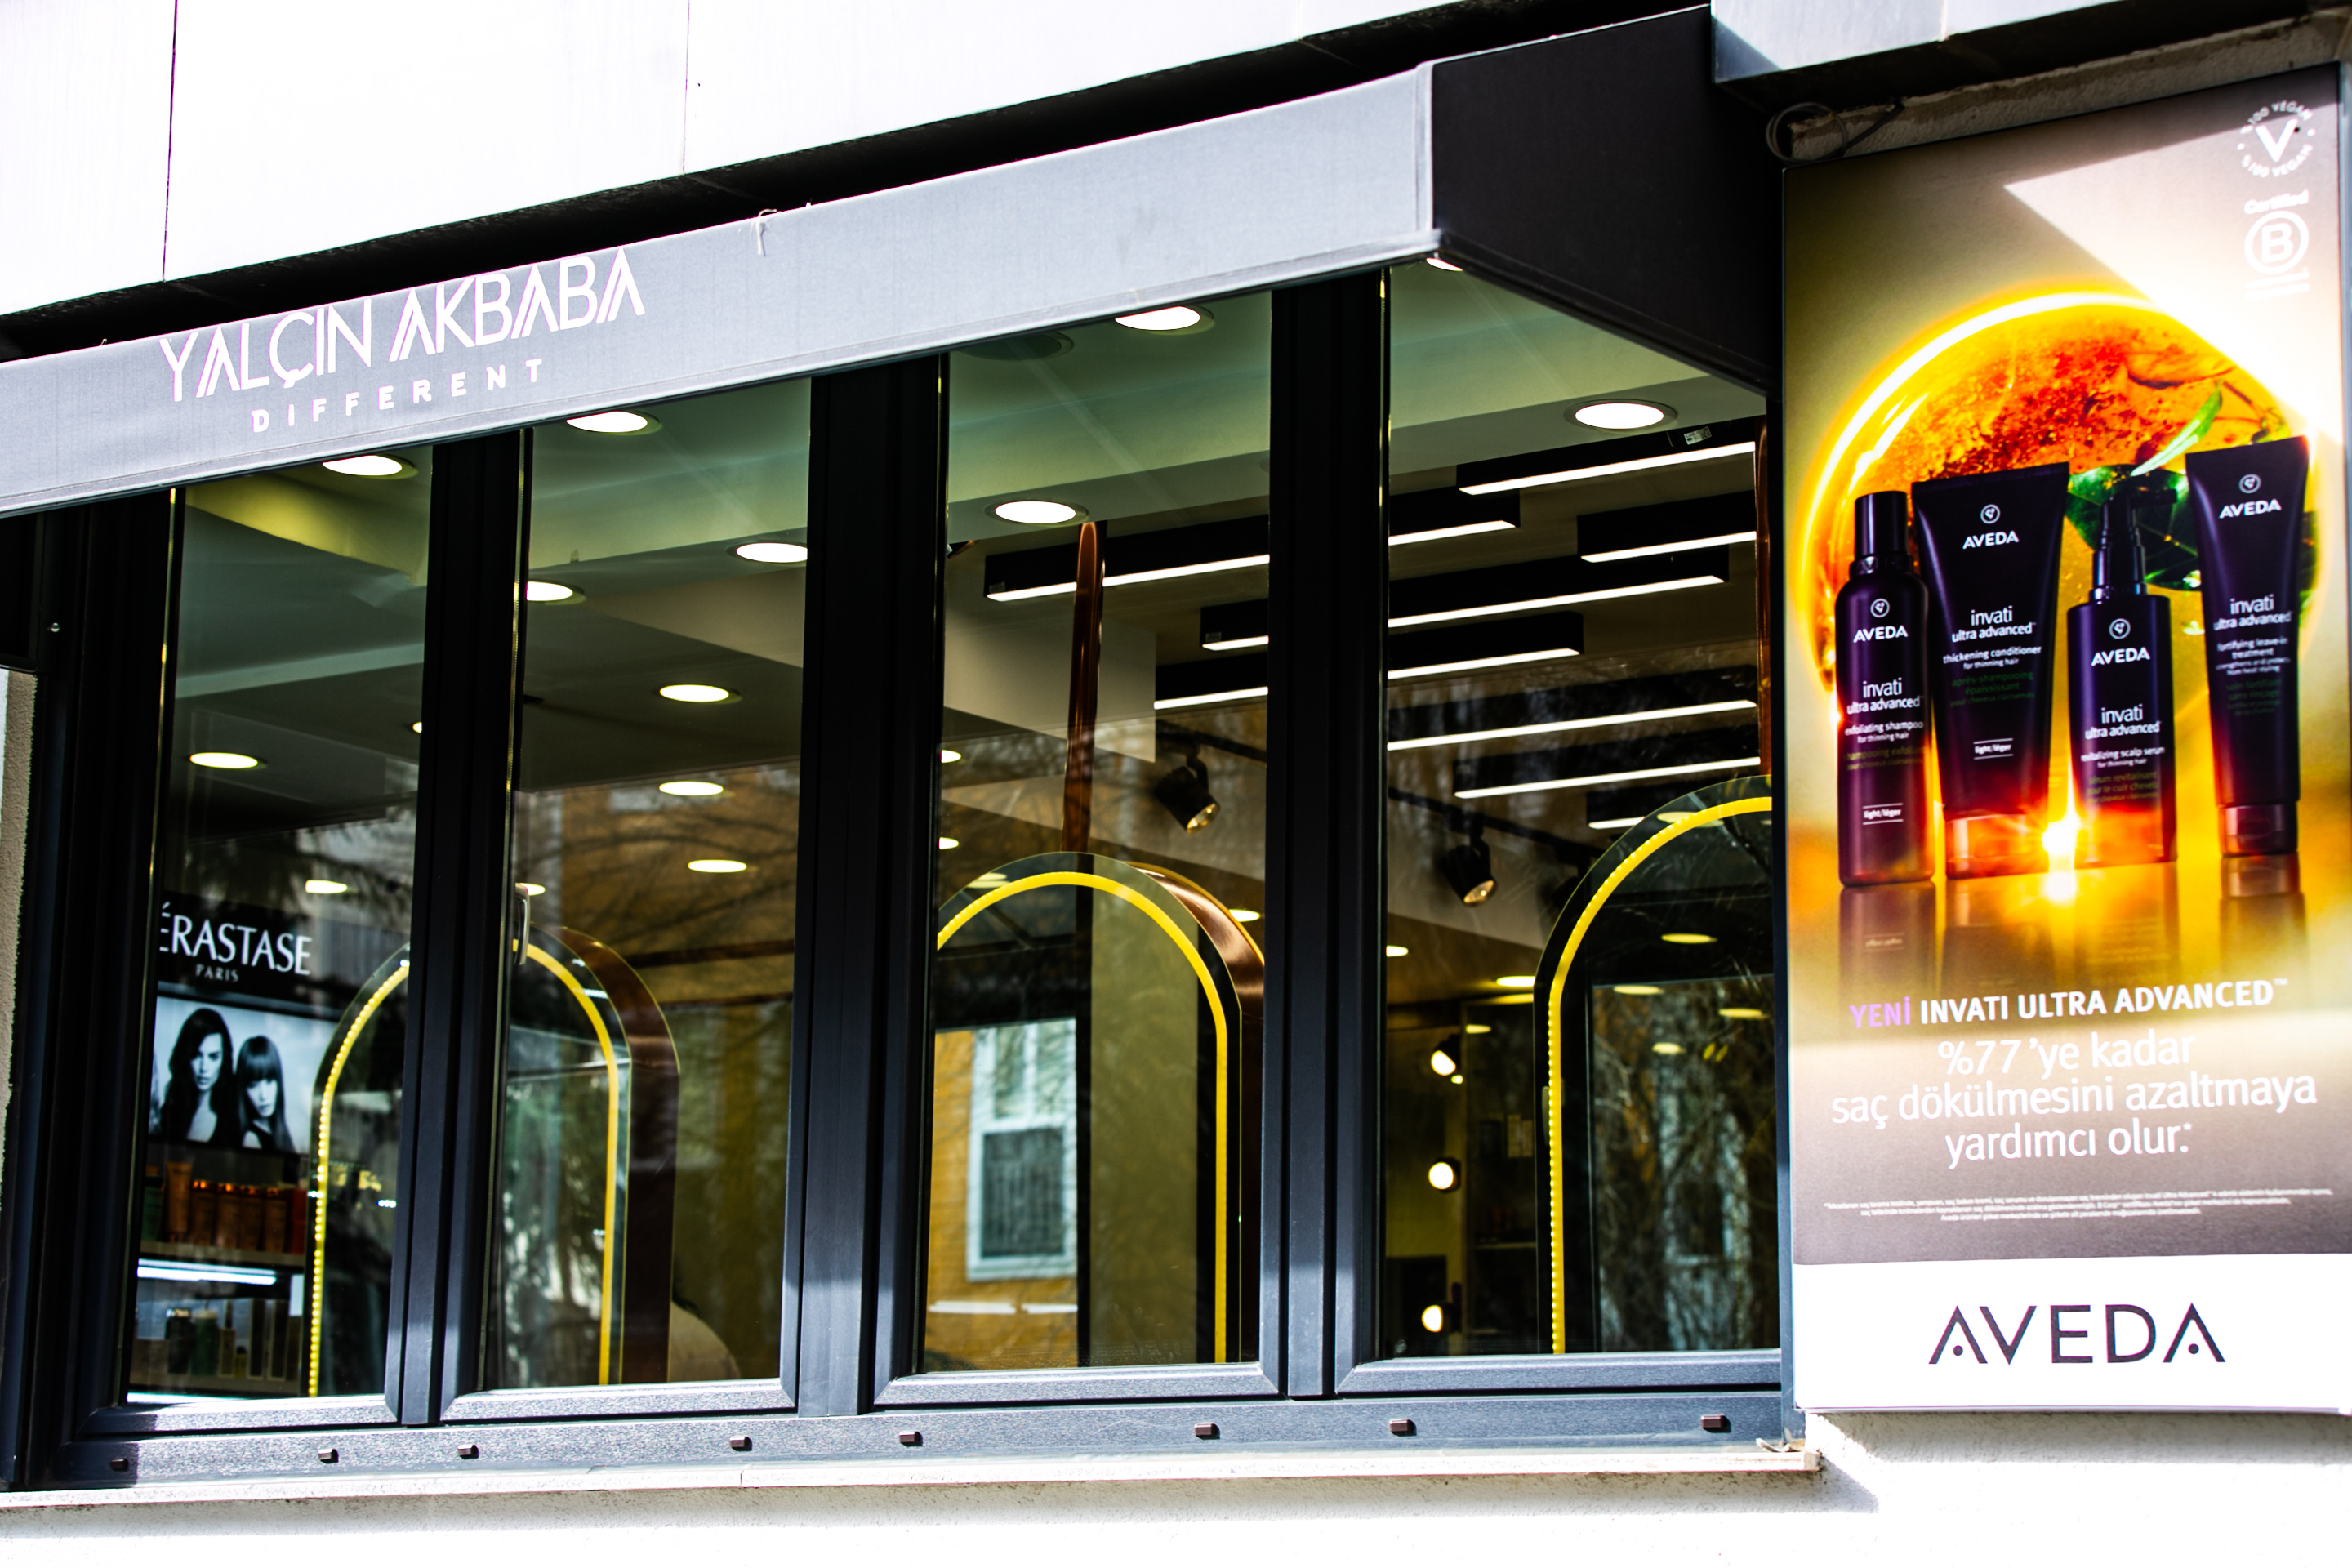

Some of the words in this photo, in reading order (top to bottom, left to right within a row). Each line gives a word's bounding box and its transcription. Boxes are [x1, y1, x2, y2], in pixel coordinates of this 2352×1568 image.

[2271, 100, 2313, 122] VEGAN
[2244, 189, 2309, 214] Certified
[158, 297, 372, 403] YALÇIN
[388, 246, 646, 363] AKBABA
[250, 358, 542, 434] DIFFERENT
[2218, 499, 2282, 519] AVEDA
[1962, 530, 2020, 550] AVEDA
[2230, 594, 2274, 615] invati
[1970, 605, 2013, 626] invati
[2213, 615, 2236, 630] ultra
[2238, 611, 2292, 628] advanced
[1852, 625, 1909, 644] AVEDA
[1951, 627, 1977, 643] ultra
[1942, 650, 1989, 664] thickening
[1990, 645, 2042, 657] conditioner
[2091, 647, 2151, 666] AVEDA
[1863, 677, 1902, 698] invati
[1846, 698, 1869, 715] ultra
[2101, 704, 2143, 724] invati
[1885, 721, 1924, 732] shampoo
[2085, 724, 2108, 740] ultra
[2120, 746, 2143, 758] scalp
[195, 964, 239, 982] PARIS
[1849, 996, 1911, 1029] YENİ
[1920, 995, 2009, 1025] INVATI
[2018, 989, 2107, 1020] ULTRA
[2091, 1028, 2196, 1069] kadar
[1831, 1094, 1889, 1130] saç
[1898, 1076, 2114, 1120] dökülmesini
[2125, 1070, 2318, 1114] azaltmaya
[1944, 1121, 2096, 1169] yardımcı
[1928, 1302, 2226, 1365] AVEDA
